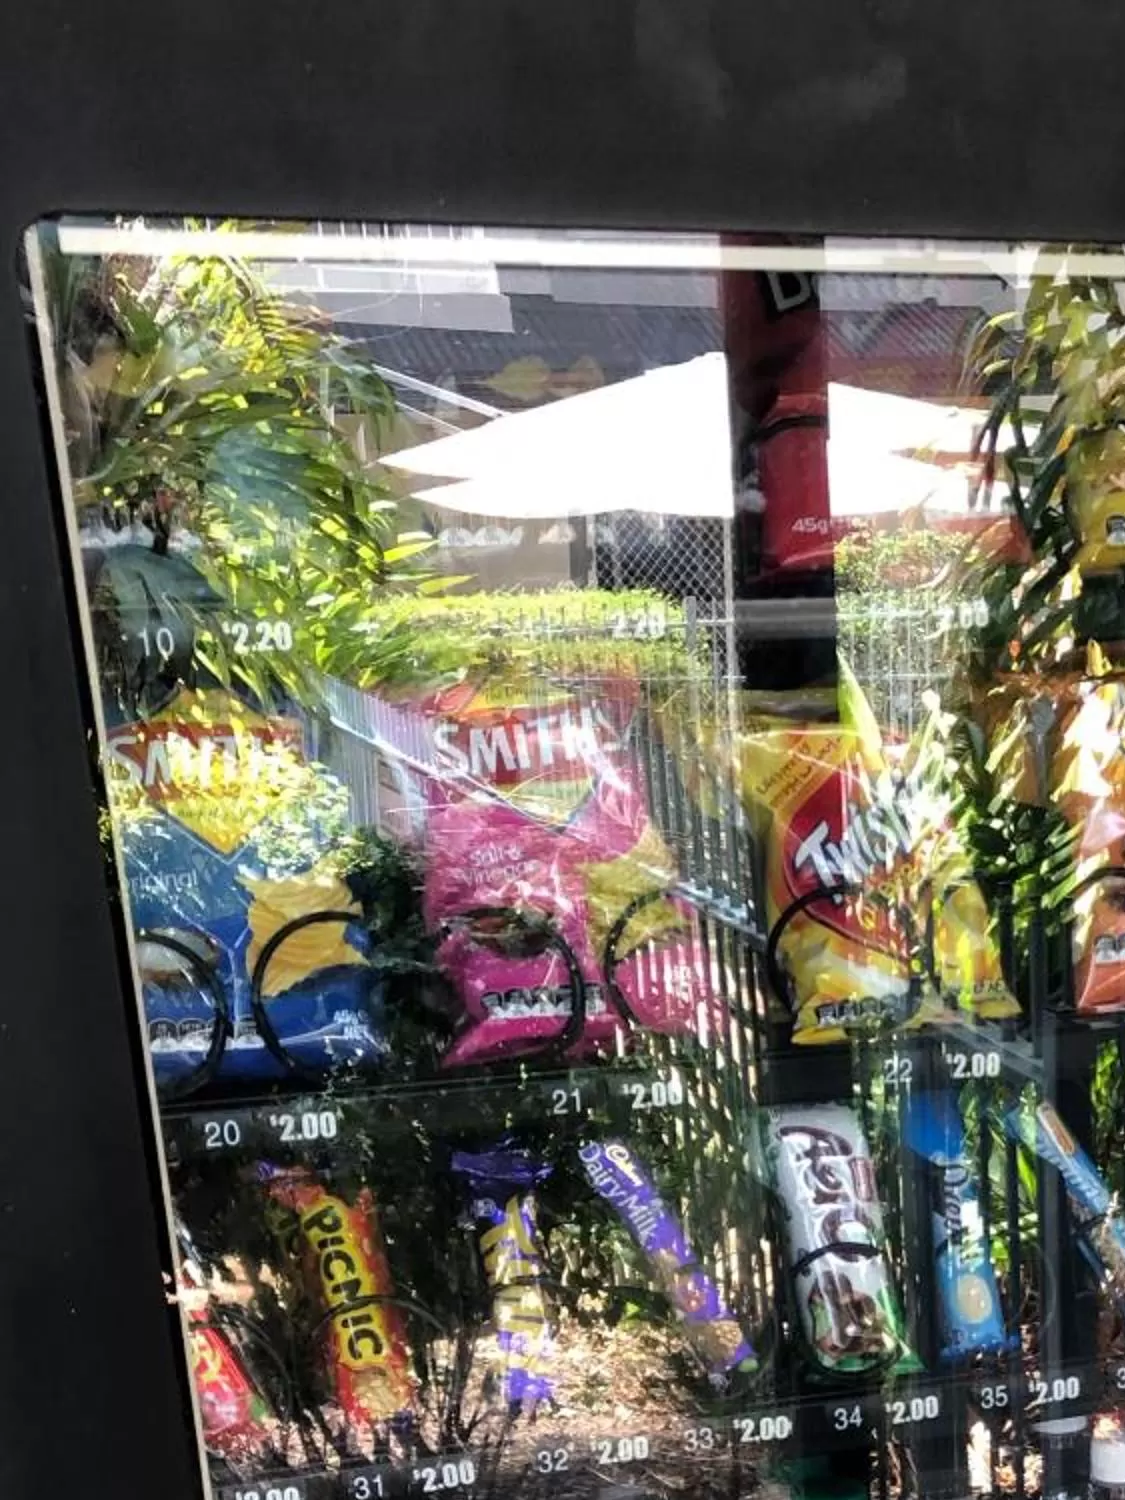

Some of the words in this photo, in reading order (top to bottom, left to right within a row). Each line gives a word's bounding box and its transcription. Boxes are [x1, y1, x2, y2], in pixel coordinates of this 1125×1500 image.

[138, 628, 175, 657] 10
[883, 1058, 912, 1082] 22
[552, 1089, 582, 1115] 21
[203, 1119, 241, 1149] 20
[578, 1141, 628, 1201] Dairy
[620, 1191, 660, 1250] Milk
[981, 1386, 1010, 1409] 35
[834, 1408, 864, 1431] 34
[684, 1428, 715, 1450] 33
[536, 1450, 569, 1473] 32
[353, 1476, 384, 1500] 31
